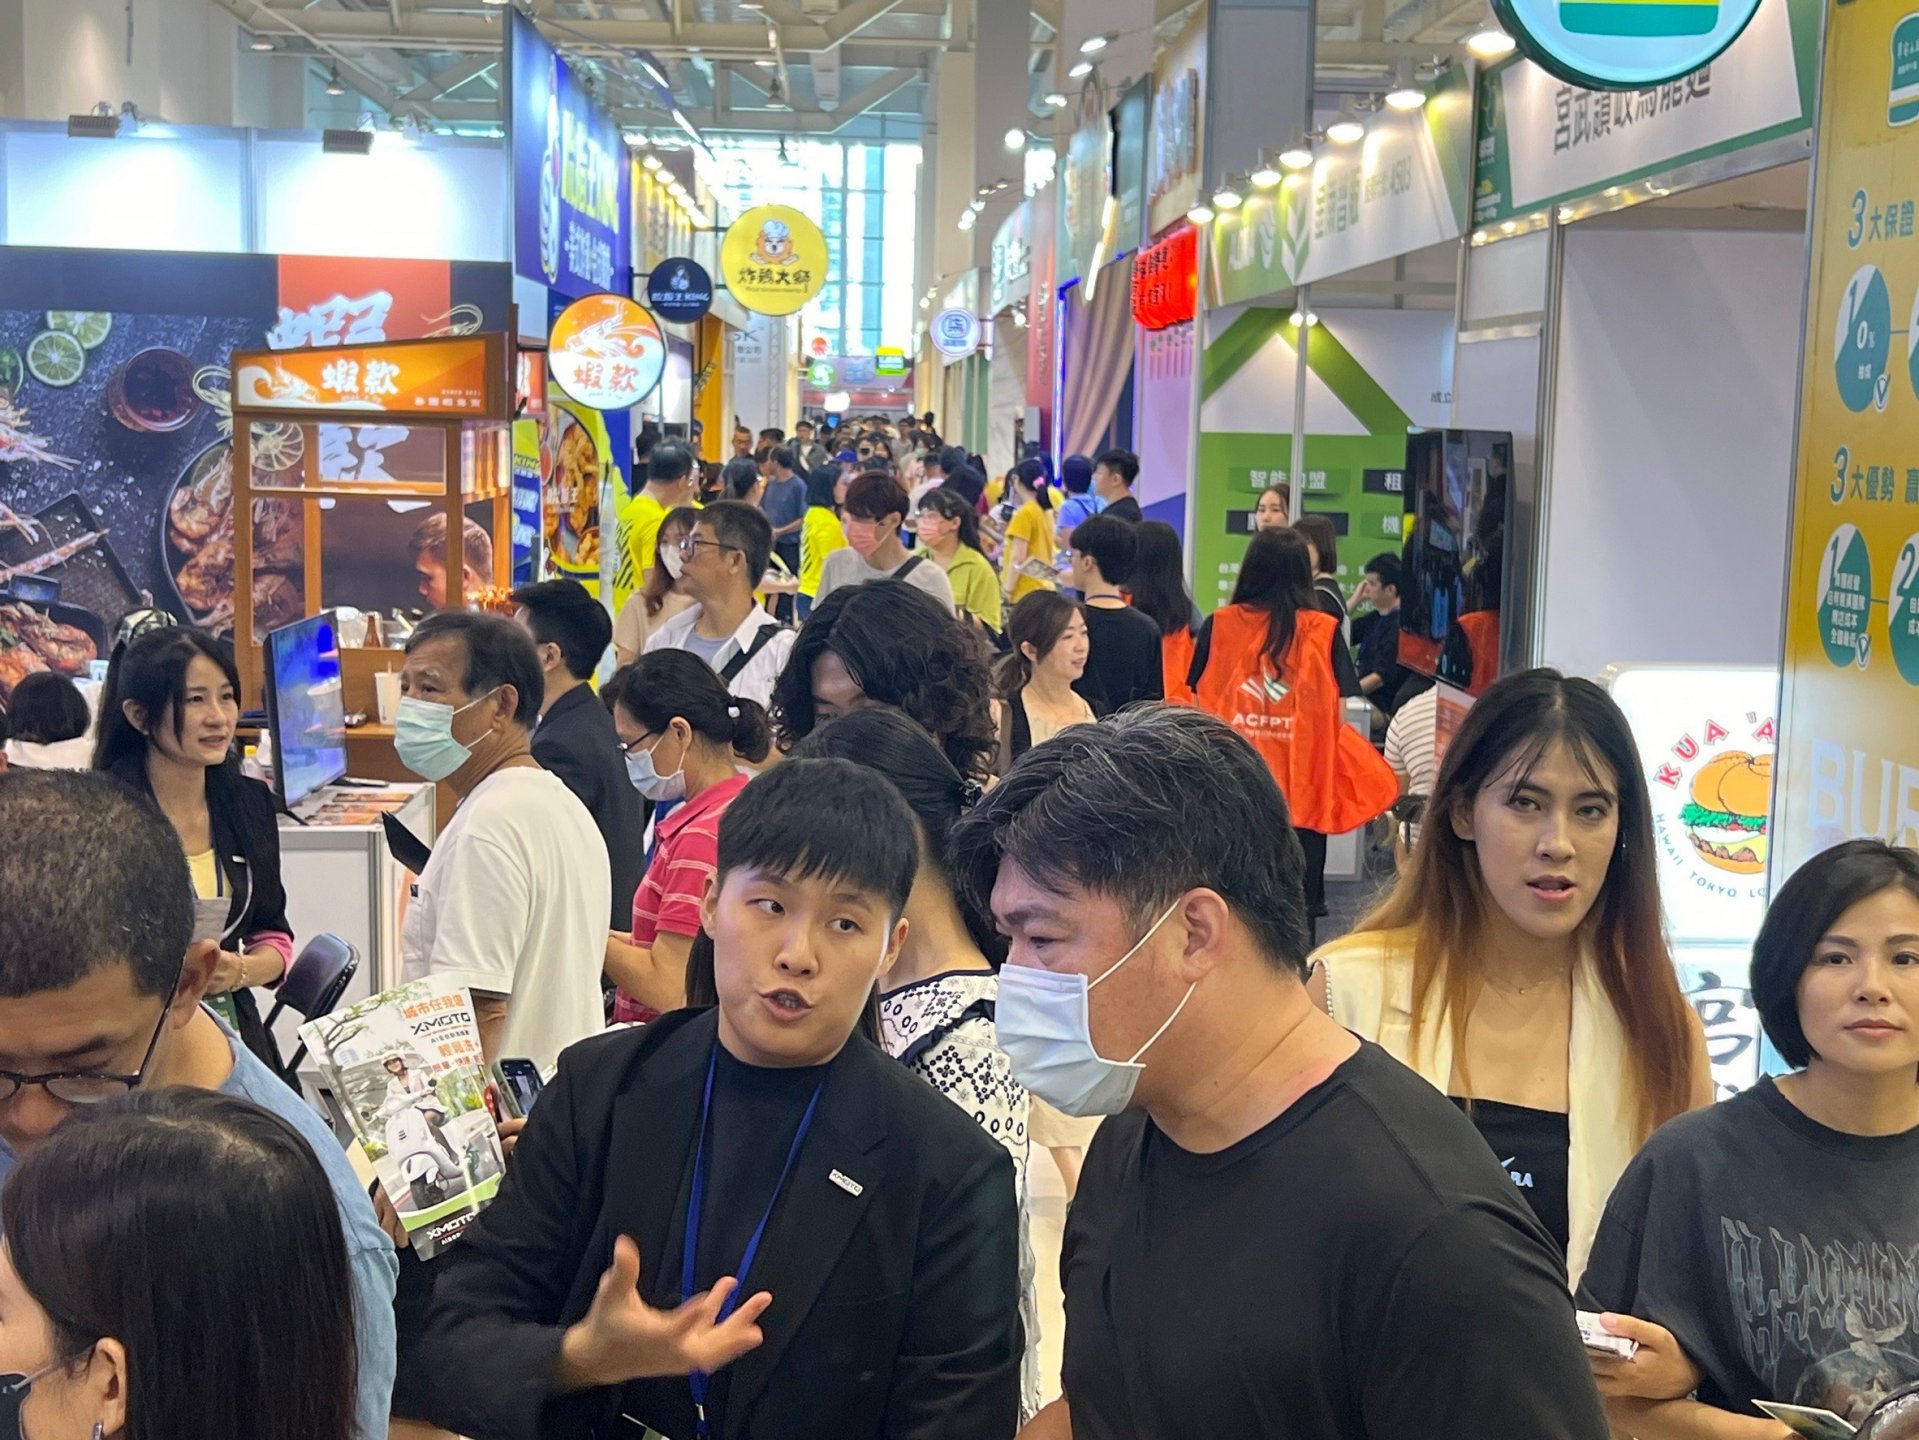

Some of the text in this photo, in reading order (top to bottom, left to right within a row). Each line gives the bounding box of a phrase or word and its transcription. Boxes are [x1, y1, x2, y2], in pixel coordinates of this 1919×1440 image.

[1849, 189, 1915, 247] 3大保證
[1830, 447, 1895, 503] 3大優勢
[1231, 712, 1293, 729] ACFPT
[1655, 813, 1684, 868] HAWAII
[1688, 870, 1738, 899] TOKYO
[410, 1012, 471, 1036] XMOTO
